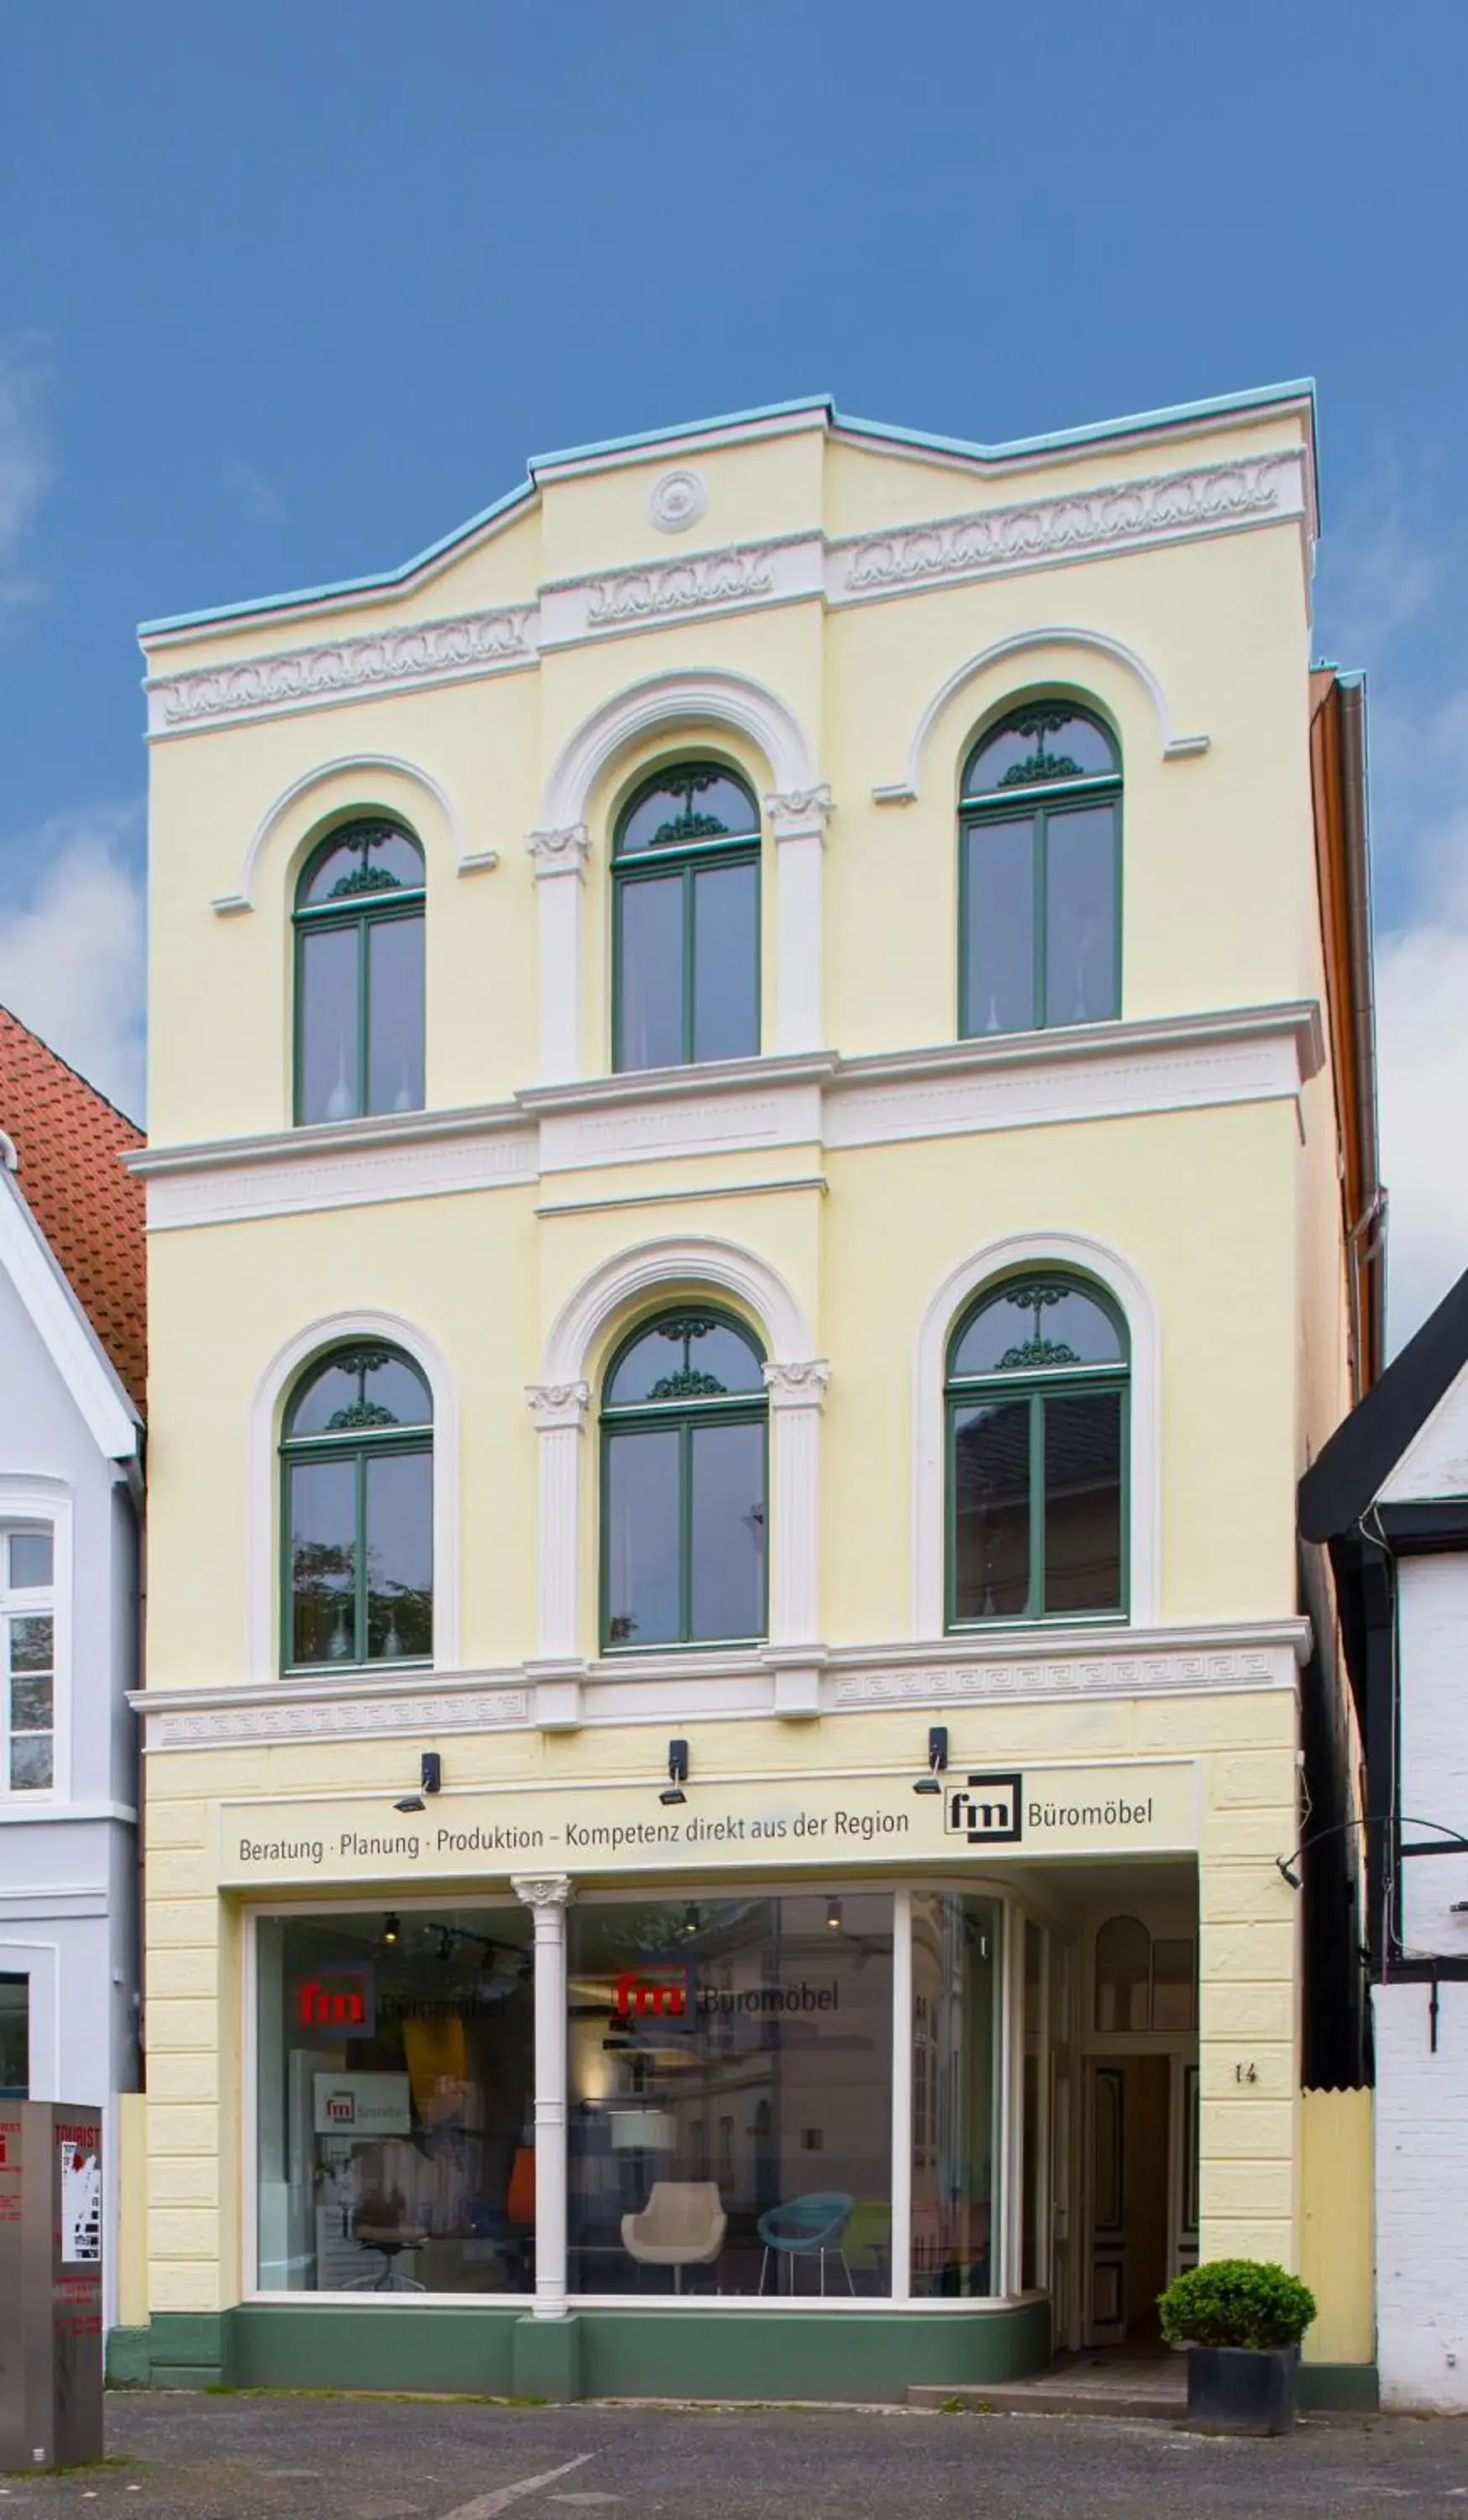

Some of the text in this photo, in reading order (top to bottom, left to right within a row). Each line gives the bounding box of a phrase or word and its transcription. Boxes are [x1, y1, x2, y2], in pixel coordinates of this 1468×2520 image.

[1029, 1798, 1152, 1827] Büromöbel
[239, 1839, 322, 1863] Beratung
[339, 1834, 419, 1858] Planung
[437, 1827, 543, 1851] Produktion
[565, 1821, 679, 1850] Kompetenz
[685, 1816, 745, 1841] direkt
[751, 1819, 786, 1838] aus
[794, 1813, 826, 1836] der
[835, 1810, 909, 1840] Region
[704, 1981, 839, 2012] Büromöbel
